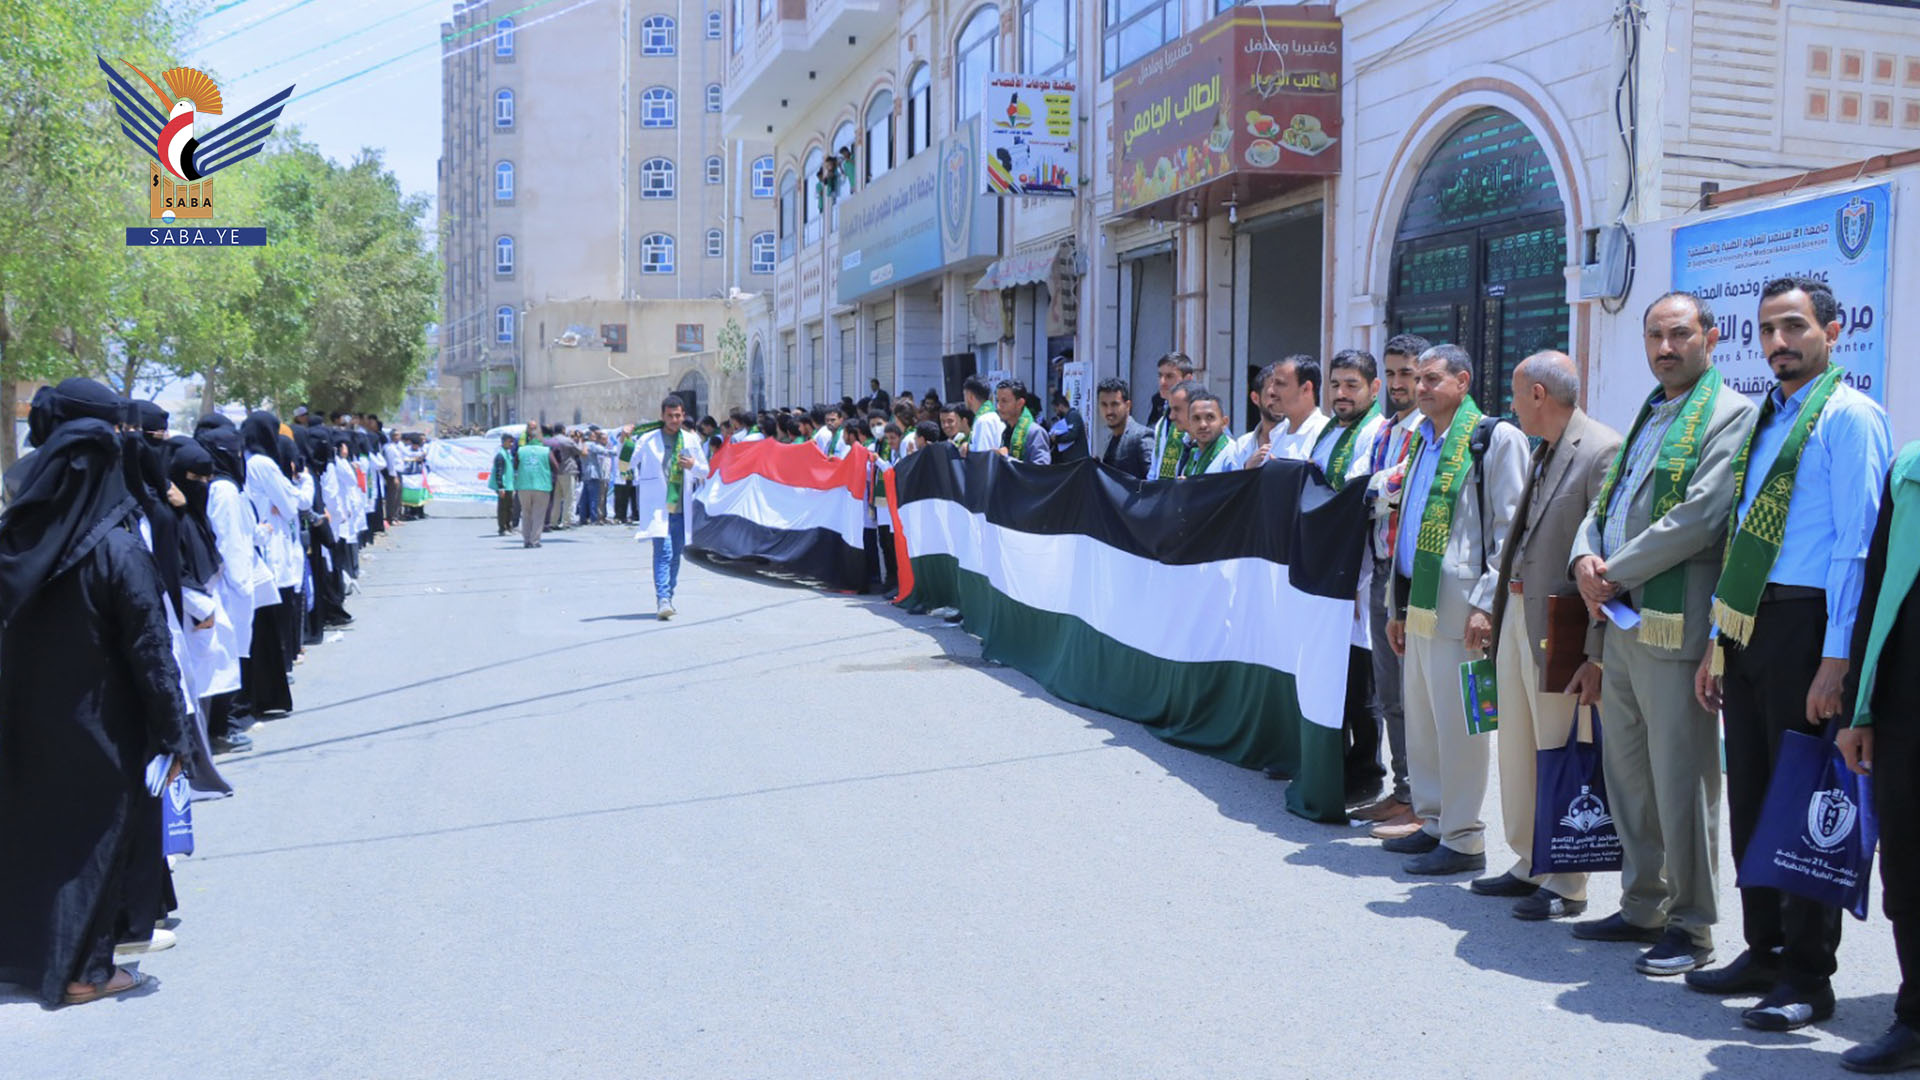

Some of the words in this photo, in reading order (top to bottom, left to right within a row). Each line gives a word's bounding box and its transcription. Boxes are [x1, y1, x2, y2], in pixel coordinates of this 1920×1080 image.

[1174, 73, 1220, 126] الطالب
[1123, 95, 1171, 153] الجامعي
[1793, 228, 1803, 238] 21
[1804, 223, 1829, 236] جامعة
[1725, 278, 1760, 297] وخدمة
[1667, 457, 1686, 482] الله
[1831, 789, 1844, 800] 21
[1812, 857, 1823, 866] 21
